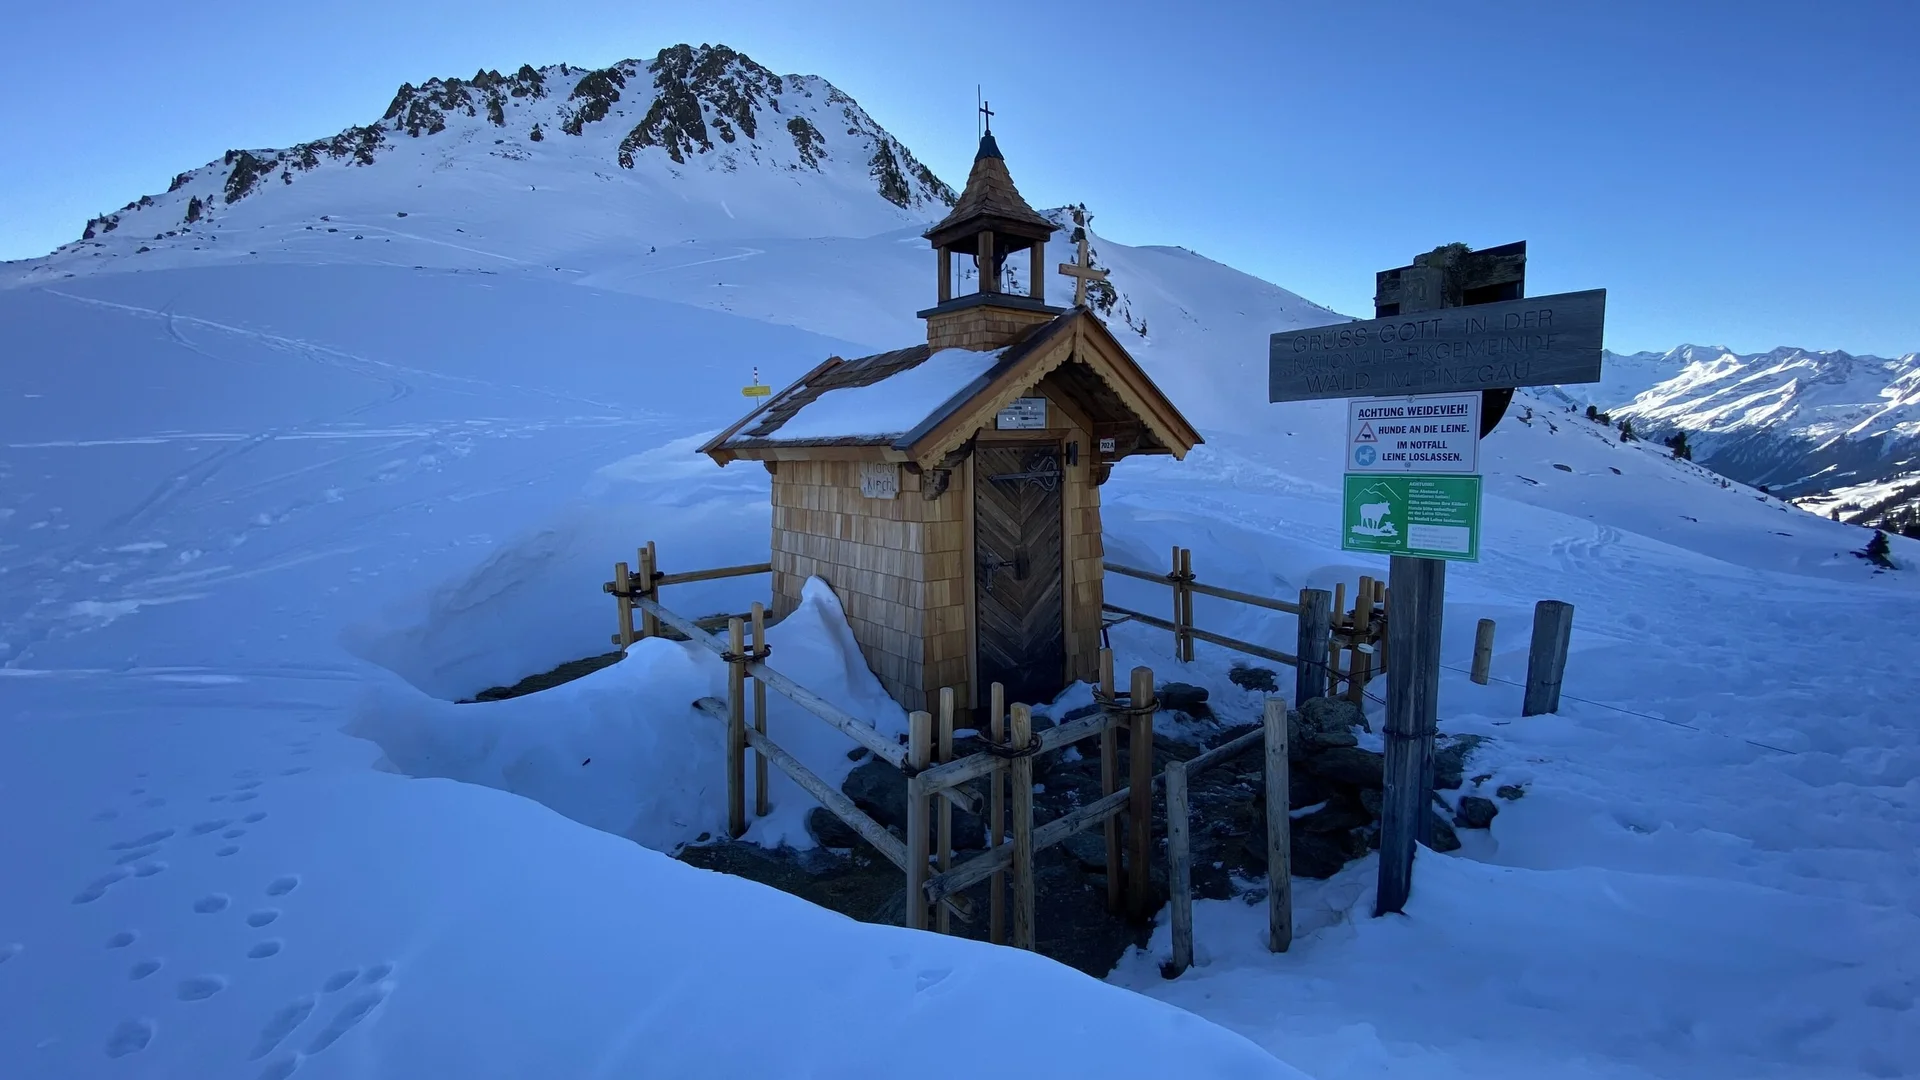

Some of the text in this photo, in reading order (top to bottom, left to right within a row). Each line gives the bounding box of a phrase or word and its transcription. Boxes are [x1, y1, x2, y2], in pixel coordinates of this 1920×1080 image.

[1293, 309, 1552, 353] GRÜSS GOTT IN DER
[1306, 362, 1530, 393] WALD IM PINZGAU
[1358, 404, 1468, 418] ACHTUNG WEIDEVIEH!
[1378, 424, 1469, 434] HUNDE AN DIE LEINE.
[1397, 440, 1447, 449] IM NOTFALL
[1382, 453, 1462, 461] LEINE LOSLASSEN.
